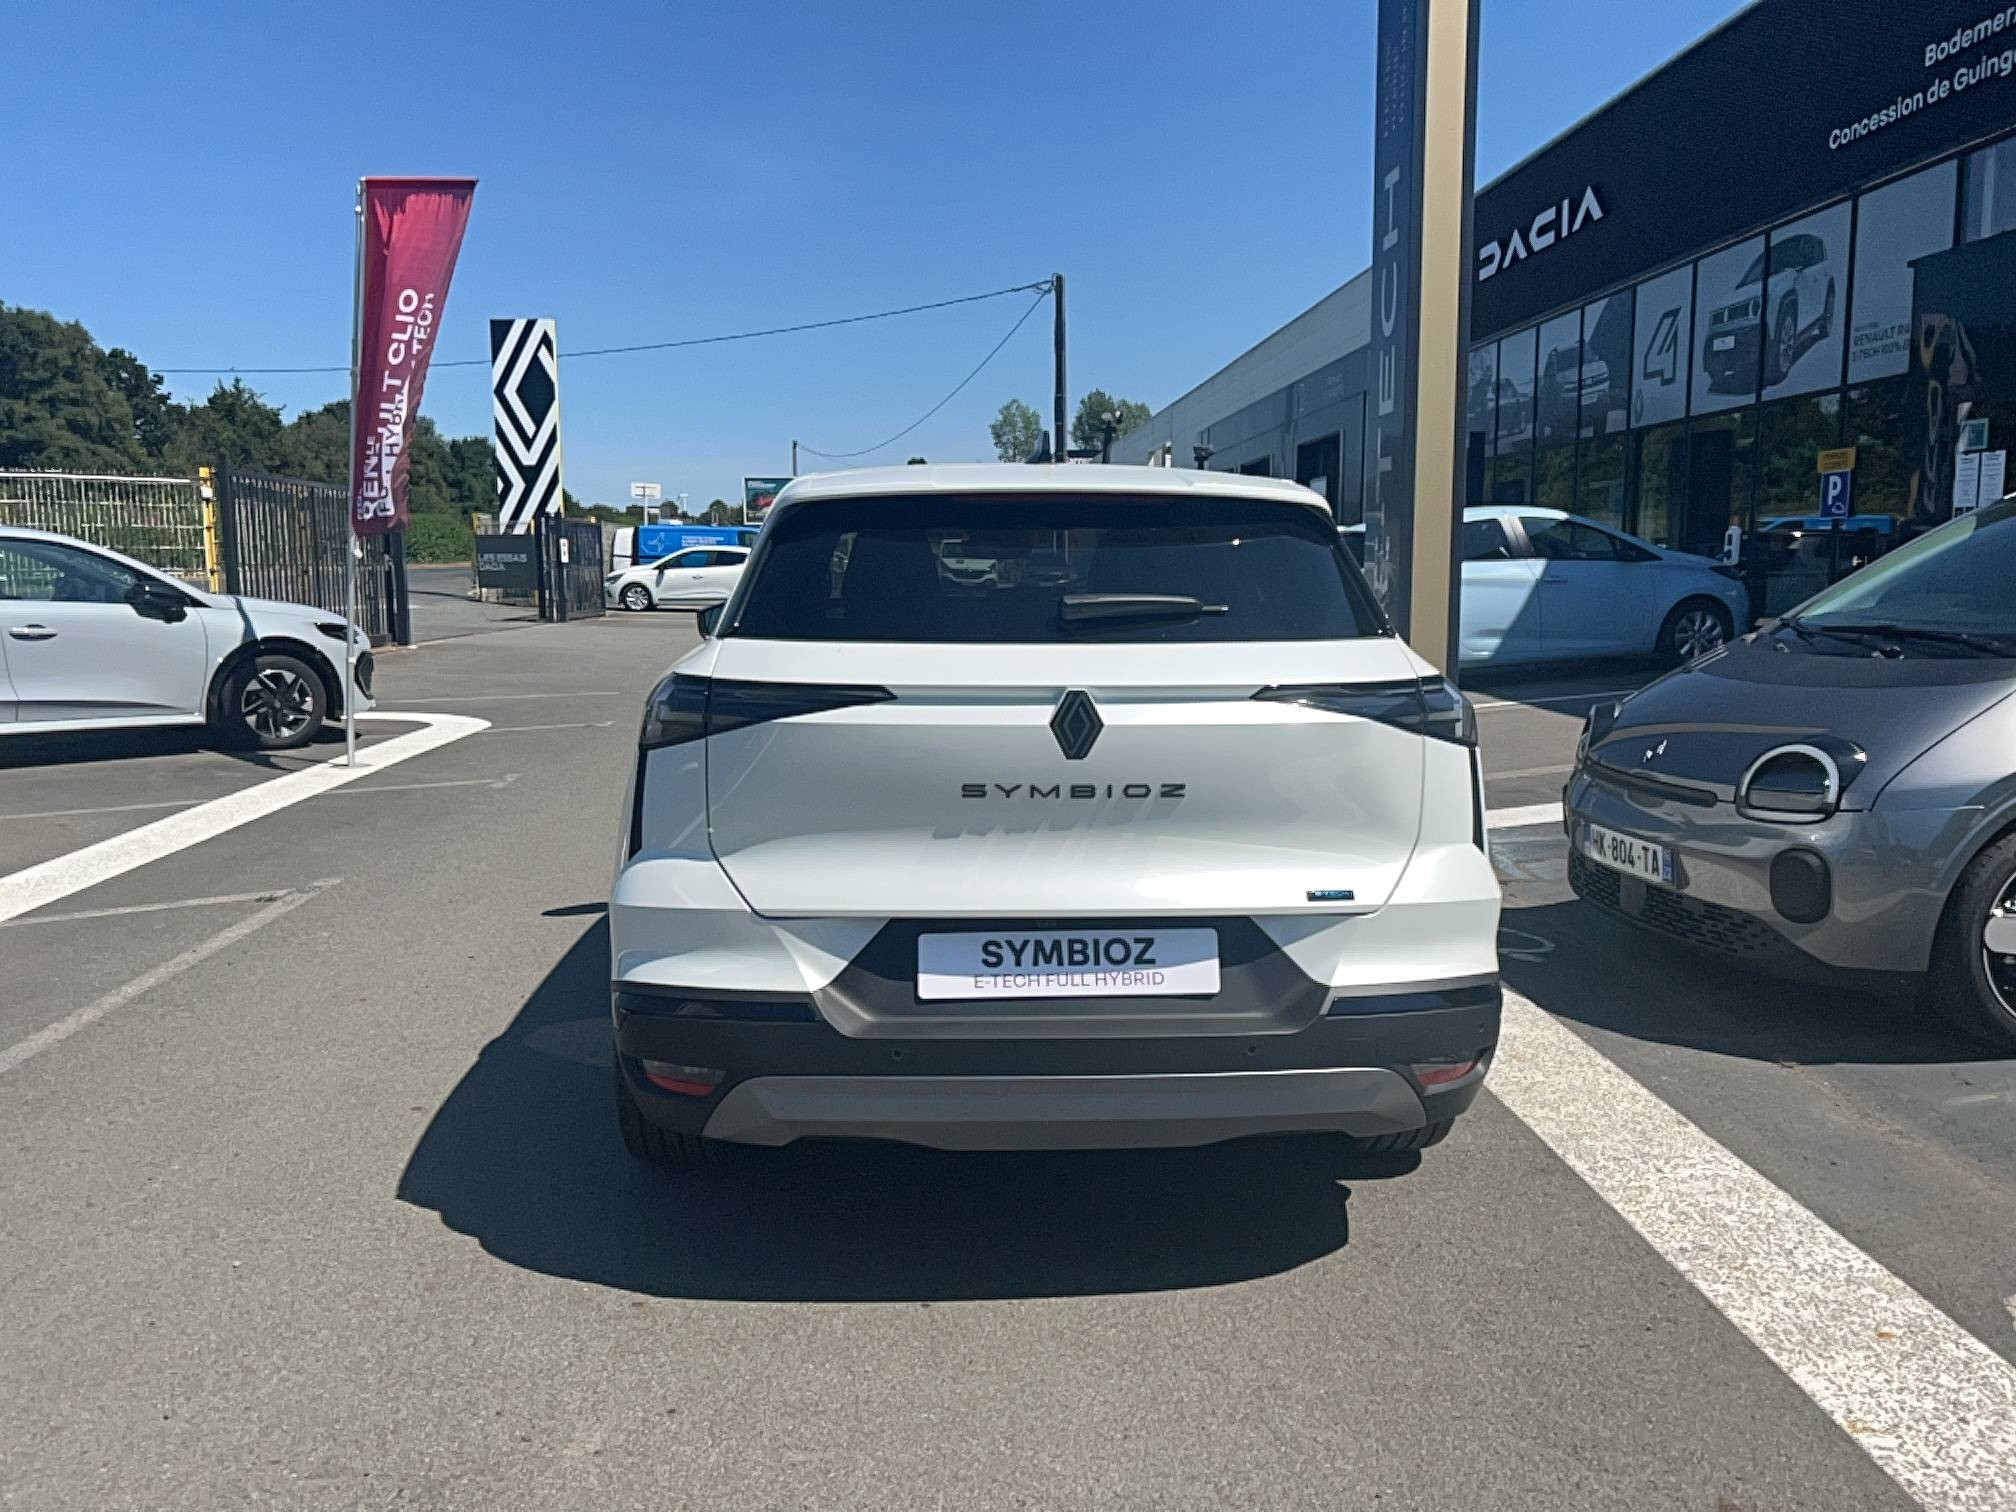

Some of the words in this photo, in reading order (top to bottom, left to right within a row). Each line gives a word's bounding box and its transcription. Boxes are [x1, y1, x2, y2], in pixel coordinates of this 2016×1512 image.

[1828, 91, 1924, 149] Concession
[1926, 78, 1950, 104] de
[1953, 49, 2016, 91] Guing
[1478, 185, 1604, 281] DACIA
[388, 288, 419, 365] CLIO
[1827, 475, 1842, 505] P
[961, 783, 1186, 799] SYMBIOZ
[981, 937, 1157, 968] SYMBIOZ
[974, 974, 1041, 989] E-TECH
[1046, 973, 1088, 988] FULL
[1095, 971, 1165, 987] HYBRID
